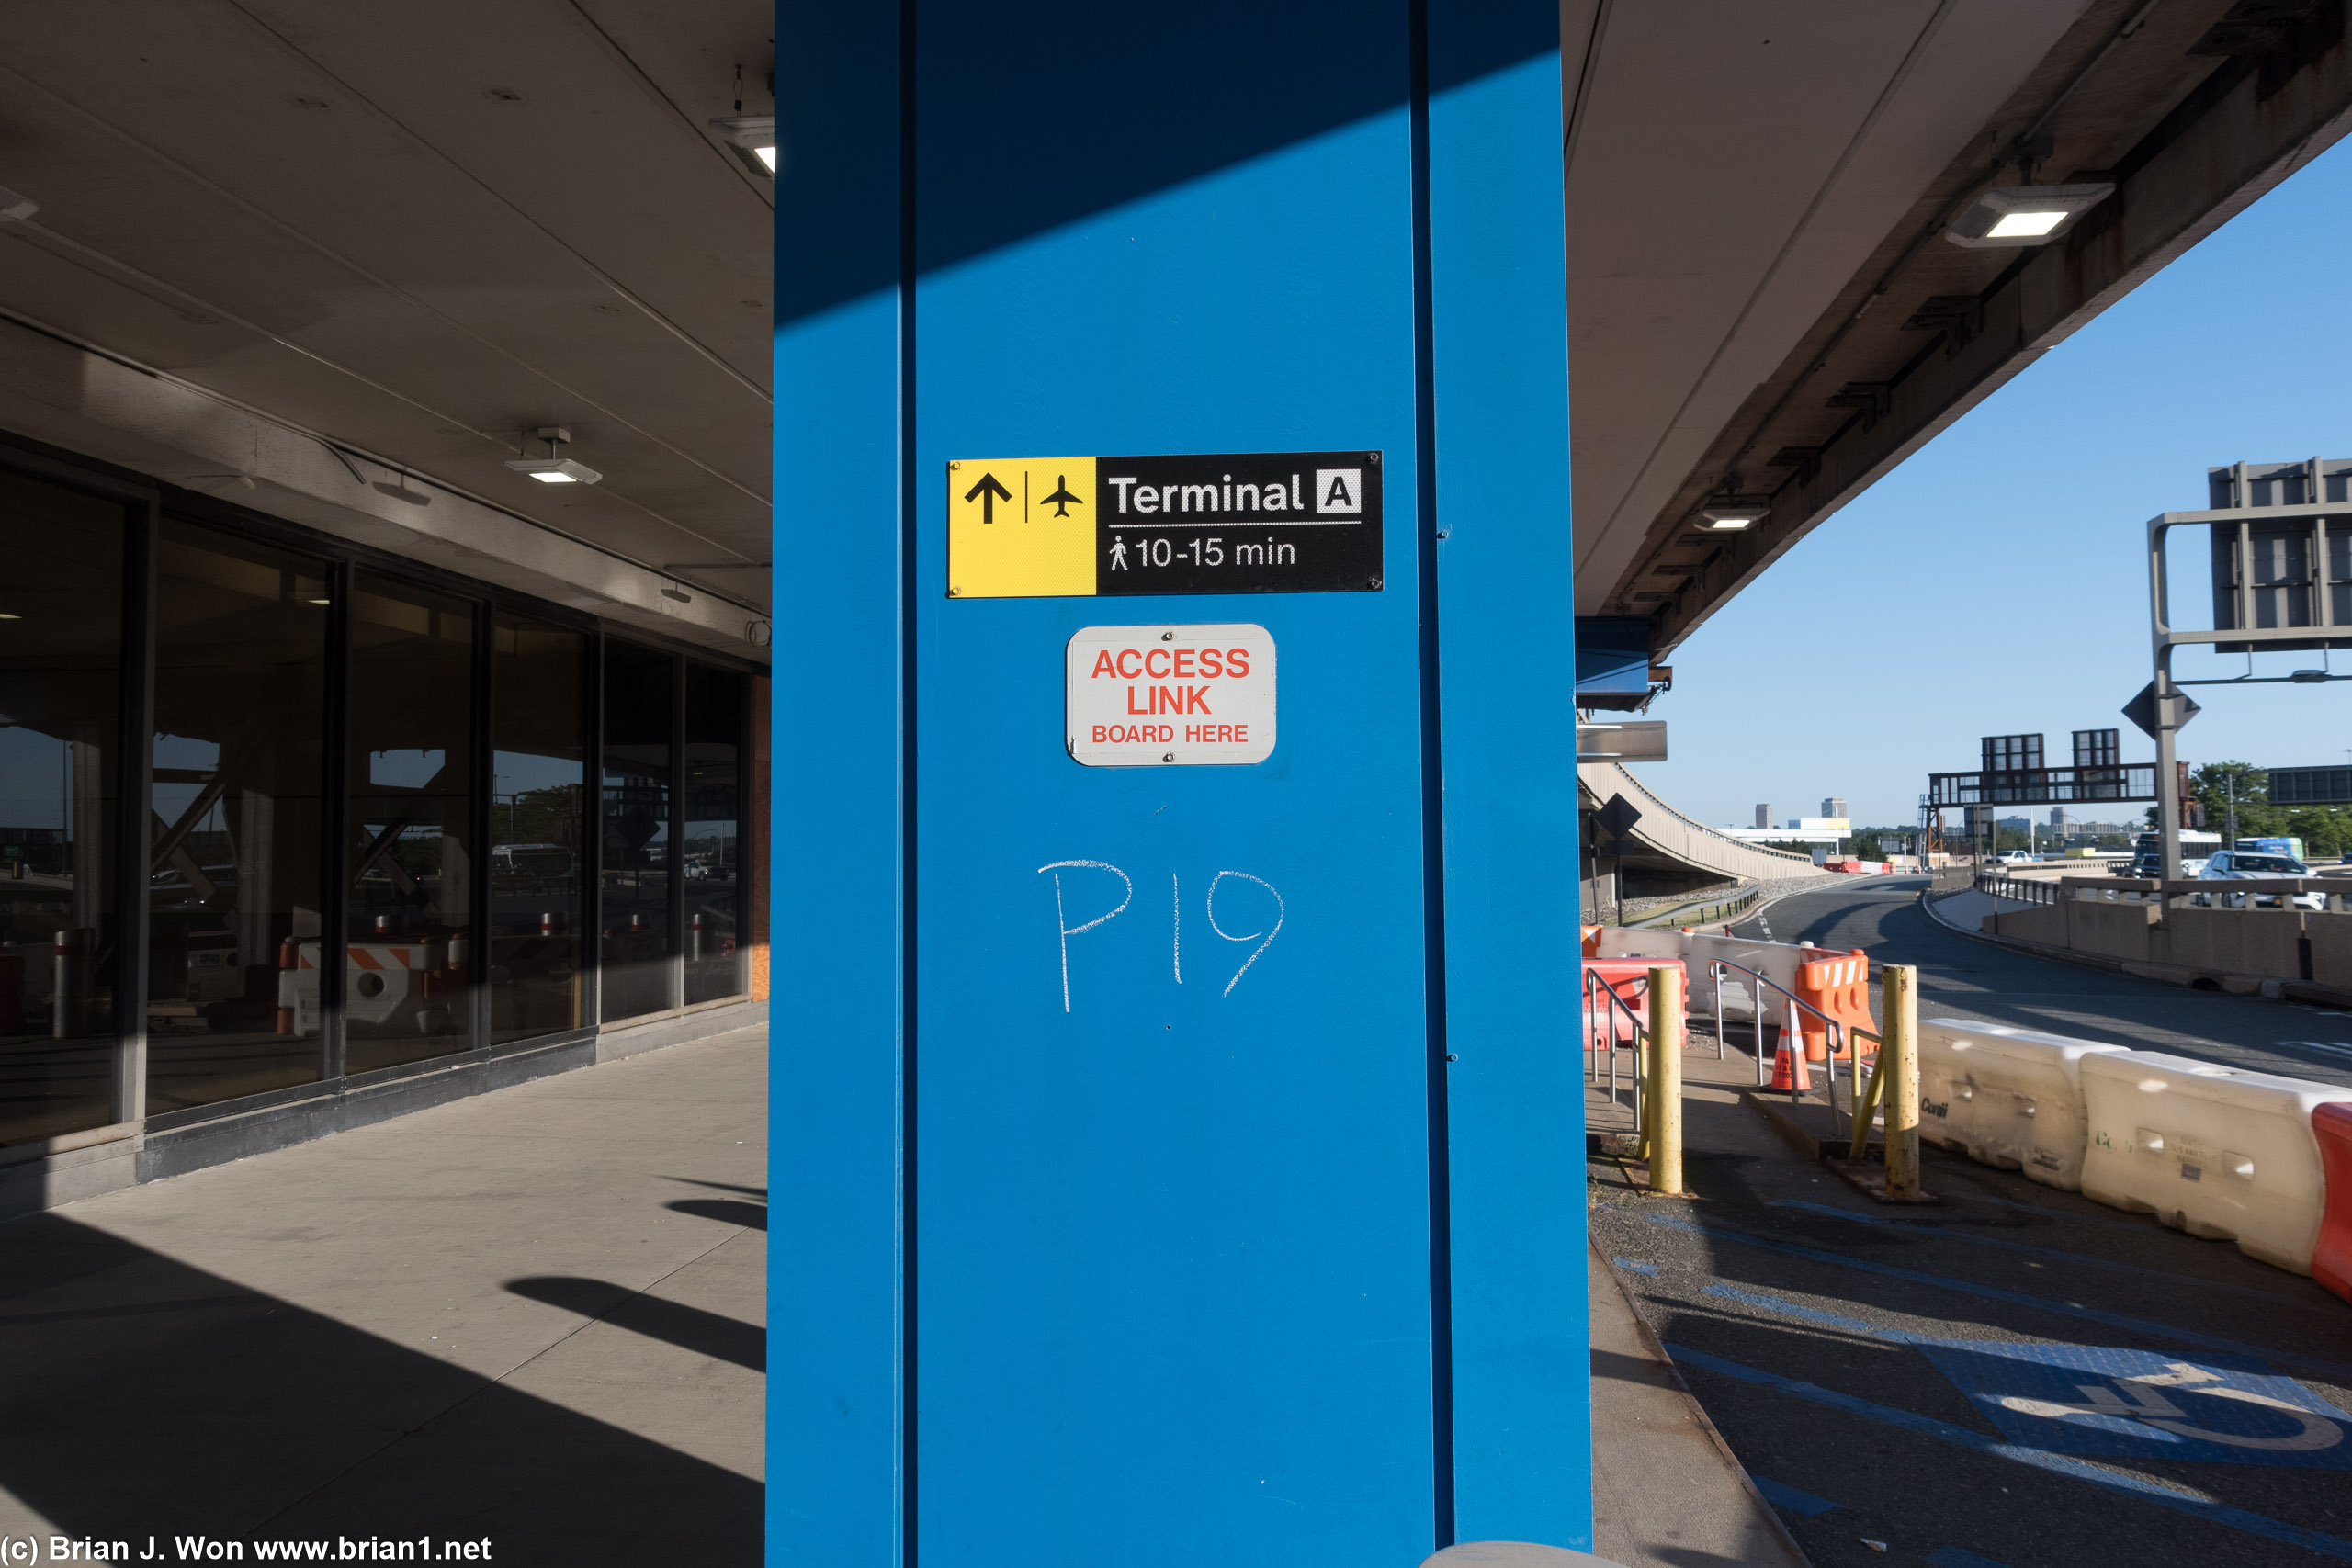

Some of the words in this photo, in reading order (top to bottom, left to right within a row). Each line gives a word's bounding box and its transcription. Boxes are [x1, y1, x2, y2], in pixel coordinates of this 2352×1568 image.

[1108, 474, 1305, 514] Terminal
[1323, 475, 1353, 508] A
[1136, 537, 1225, 568] 10-15
[1236, 536, 1296, 566] min
[1091, 648, 1251, 680] ACCESS
[1126, 685, 1212, 716] LINK
[1091, 724, 1174, 744] BOARD
[1185, 724, 1249, 744] HERE
